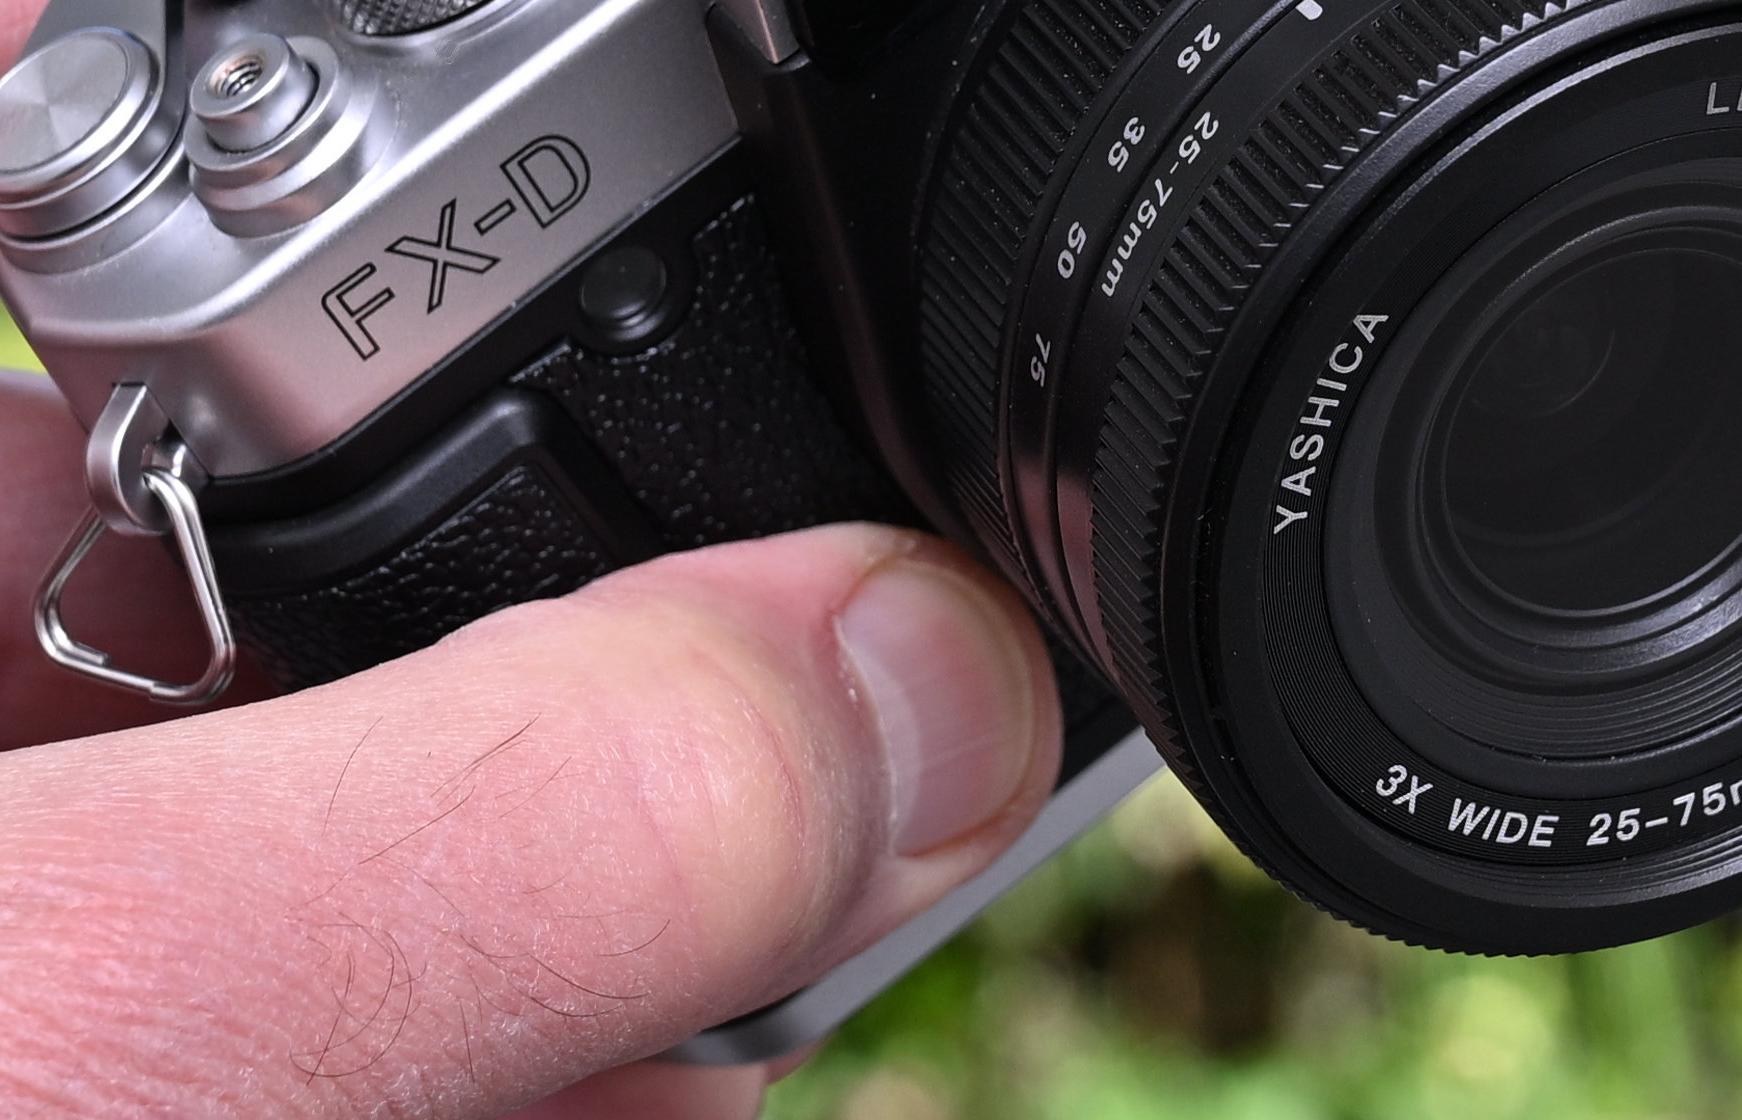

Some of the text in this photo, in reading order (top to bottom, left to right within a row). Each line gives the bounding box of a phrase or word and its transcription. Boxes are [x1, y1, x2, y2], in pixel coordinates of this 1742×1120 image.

[1176, 24, 1222, 75] 25
[1107, 116, 1146, 172] 35
[1101, 111, 1220, 298] 25-75mm
[321, 133, 592, 361] FX-D
[1057, 221, 1087, 280] 50
[1029, 333, 1052, 387] 75
[1273, 309, 1390, 536] YASHICA
[1375, 764, 1434, 814] 3X
[1447, 798, 1560, 848] WIDE
